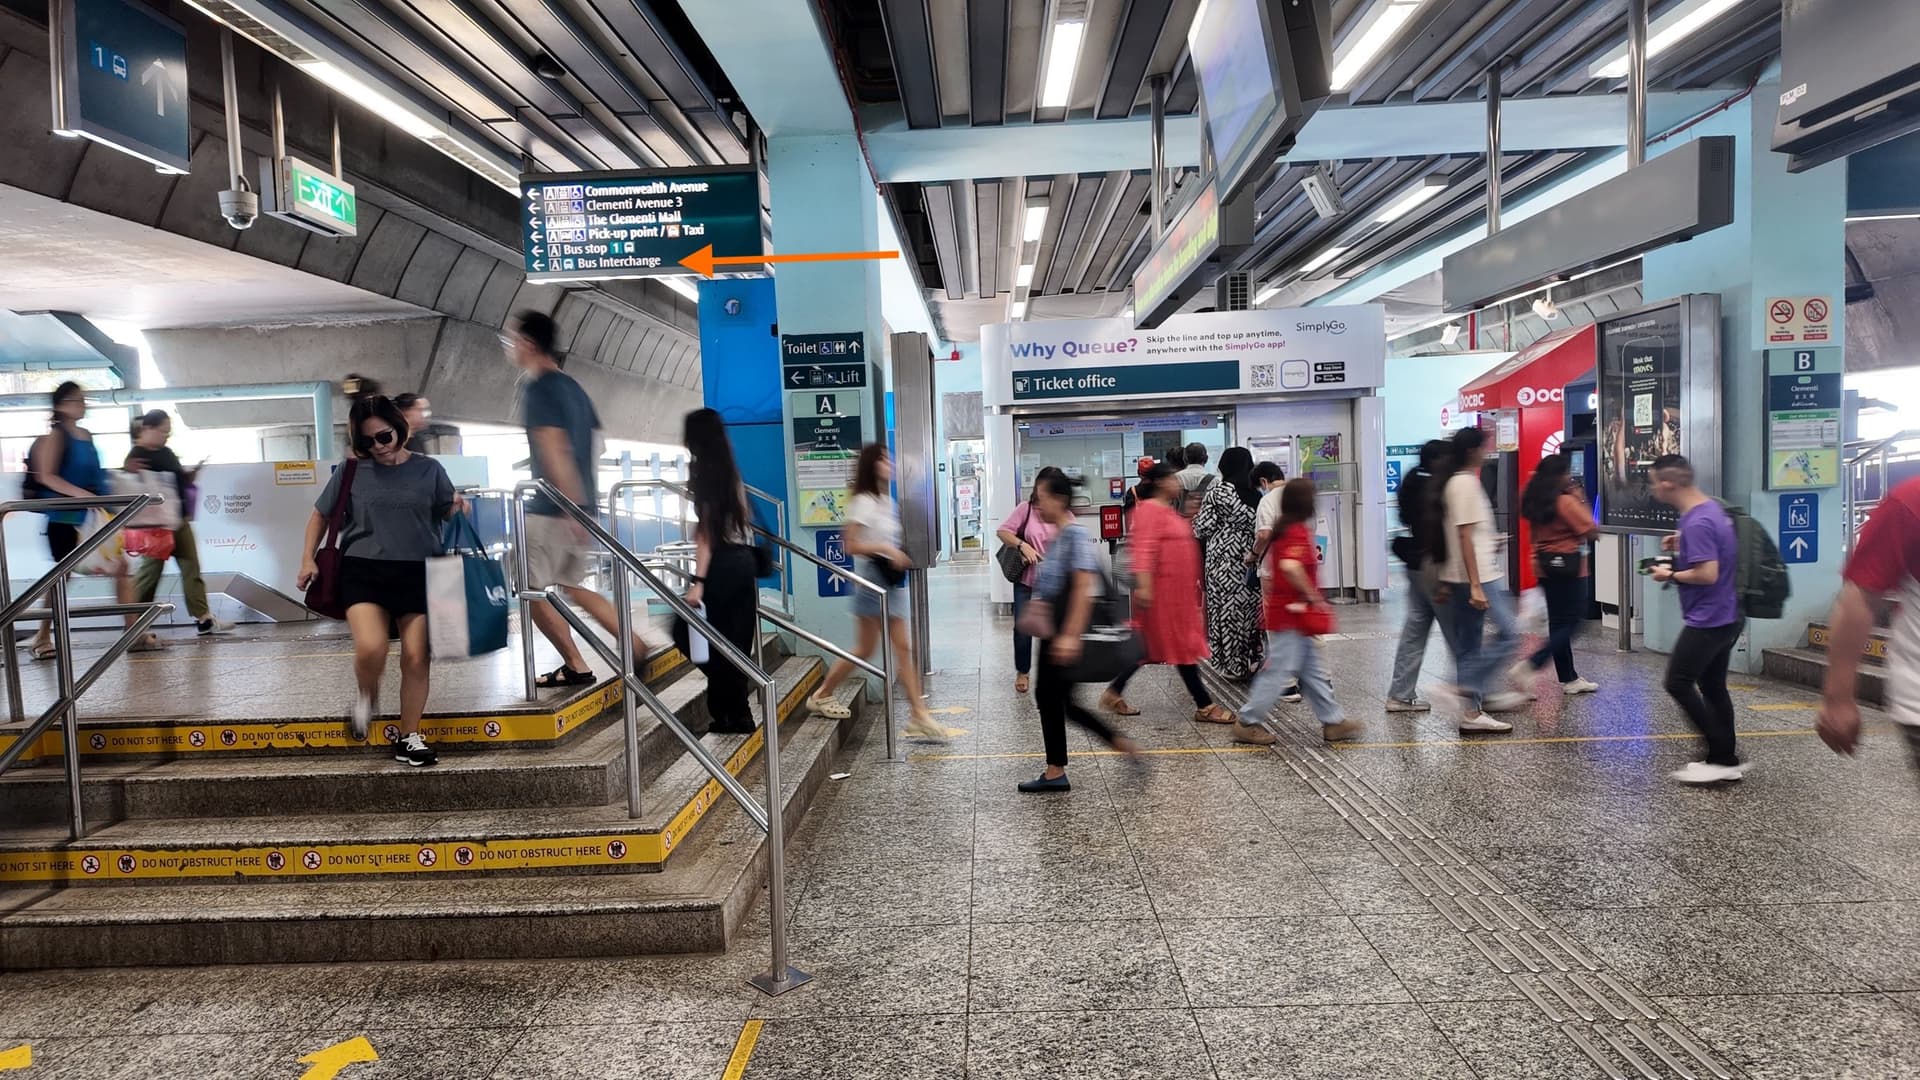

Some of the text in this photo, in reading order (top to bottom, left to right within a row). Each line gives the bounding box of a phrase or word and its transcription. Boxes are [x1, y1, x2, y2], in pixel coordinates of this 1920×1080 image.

[94, 47, 103, 68] 1
[298, 173, 334, 214] Exit
[585, 182, 667, 197] Commonwealth
[669, 182, 709, 193] Avenue
[586, 198, 633, 211] Clementi
[635, 198, 673, 209] Avenue
[675, 196, 683, 207] 3
[588, 214, 608, 225] The
[609, 212, 656, 225] Clementi
[658, 210, 682, 222] Mall
[588, 228, 628, 240] Pick-up
[630, 226, 658, 240] point
[682, 224, 705, 236] Taxi
[563, 245, 583, 255] Bus
[585, 244, 608, 256] stop
[578, 258, 597, 268] Bus
[600, 255, 662, 268] Interchange
[1296, 320, 1346, 334] SimplyGo
[1147, 336, 1164, 344] Skip
[1217, 333, 1231, 342] top
[1233, 333, 1243, 341] up
[787, 343, 817, 354] Toilet
[1010, 338, 1138, 360] Why Queue?
[1147, 340, 1286, 355] anywhere with the SimplyGo app!
[1798, 352, 1811, 370] B
[841, 370, 860, 383] Lift
[1033, 374, 1116, 391] Ticket office
[819, 396, 833, 412] A
[1464, 393, 1485, 408] OCBC
[1104, 513, 1118, 521] EXIT
[242, 730, 347, 741] DO NOT OBSTRUCT HERE
[420, 726, 479, 736] NOT SIT HERE
[111, 735, 184, 746] DO NOT SIT HERE
[328, 854, 411, 865] DO NOT SIT HERE
[480, 846, 602, 860] DO NOT OBSTRUCT HERE
[10, 863, 31, 872] NOT
[32, 862, 48, 871] SIT
[50, 861, 75, 871] HERE
[142, 856, 261, 868] DO NOT OBSTRUCT HERE
